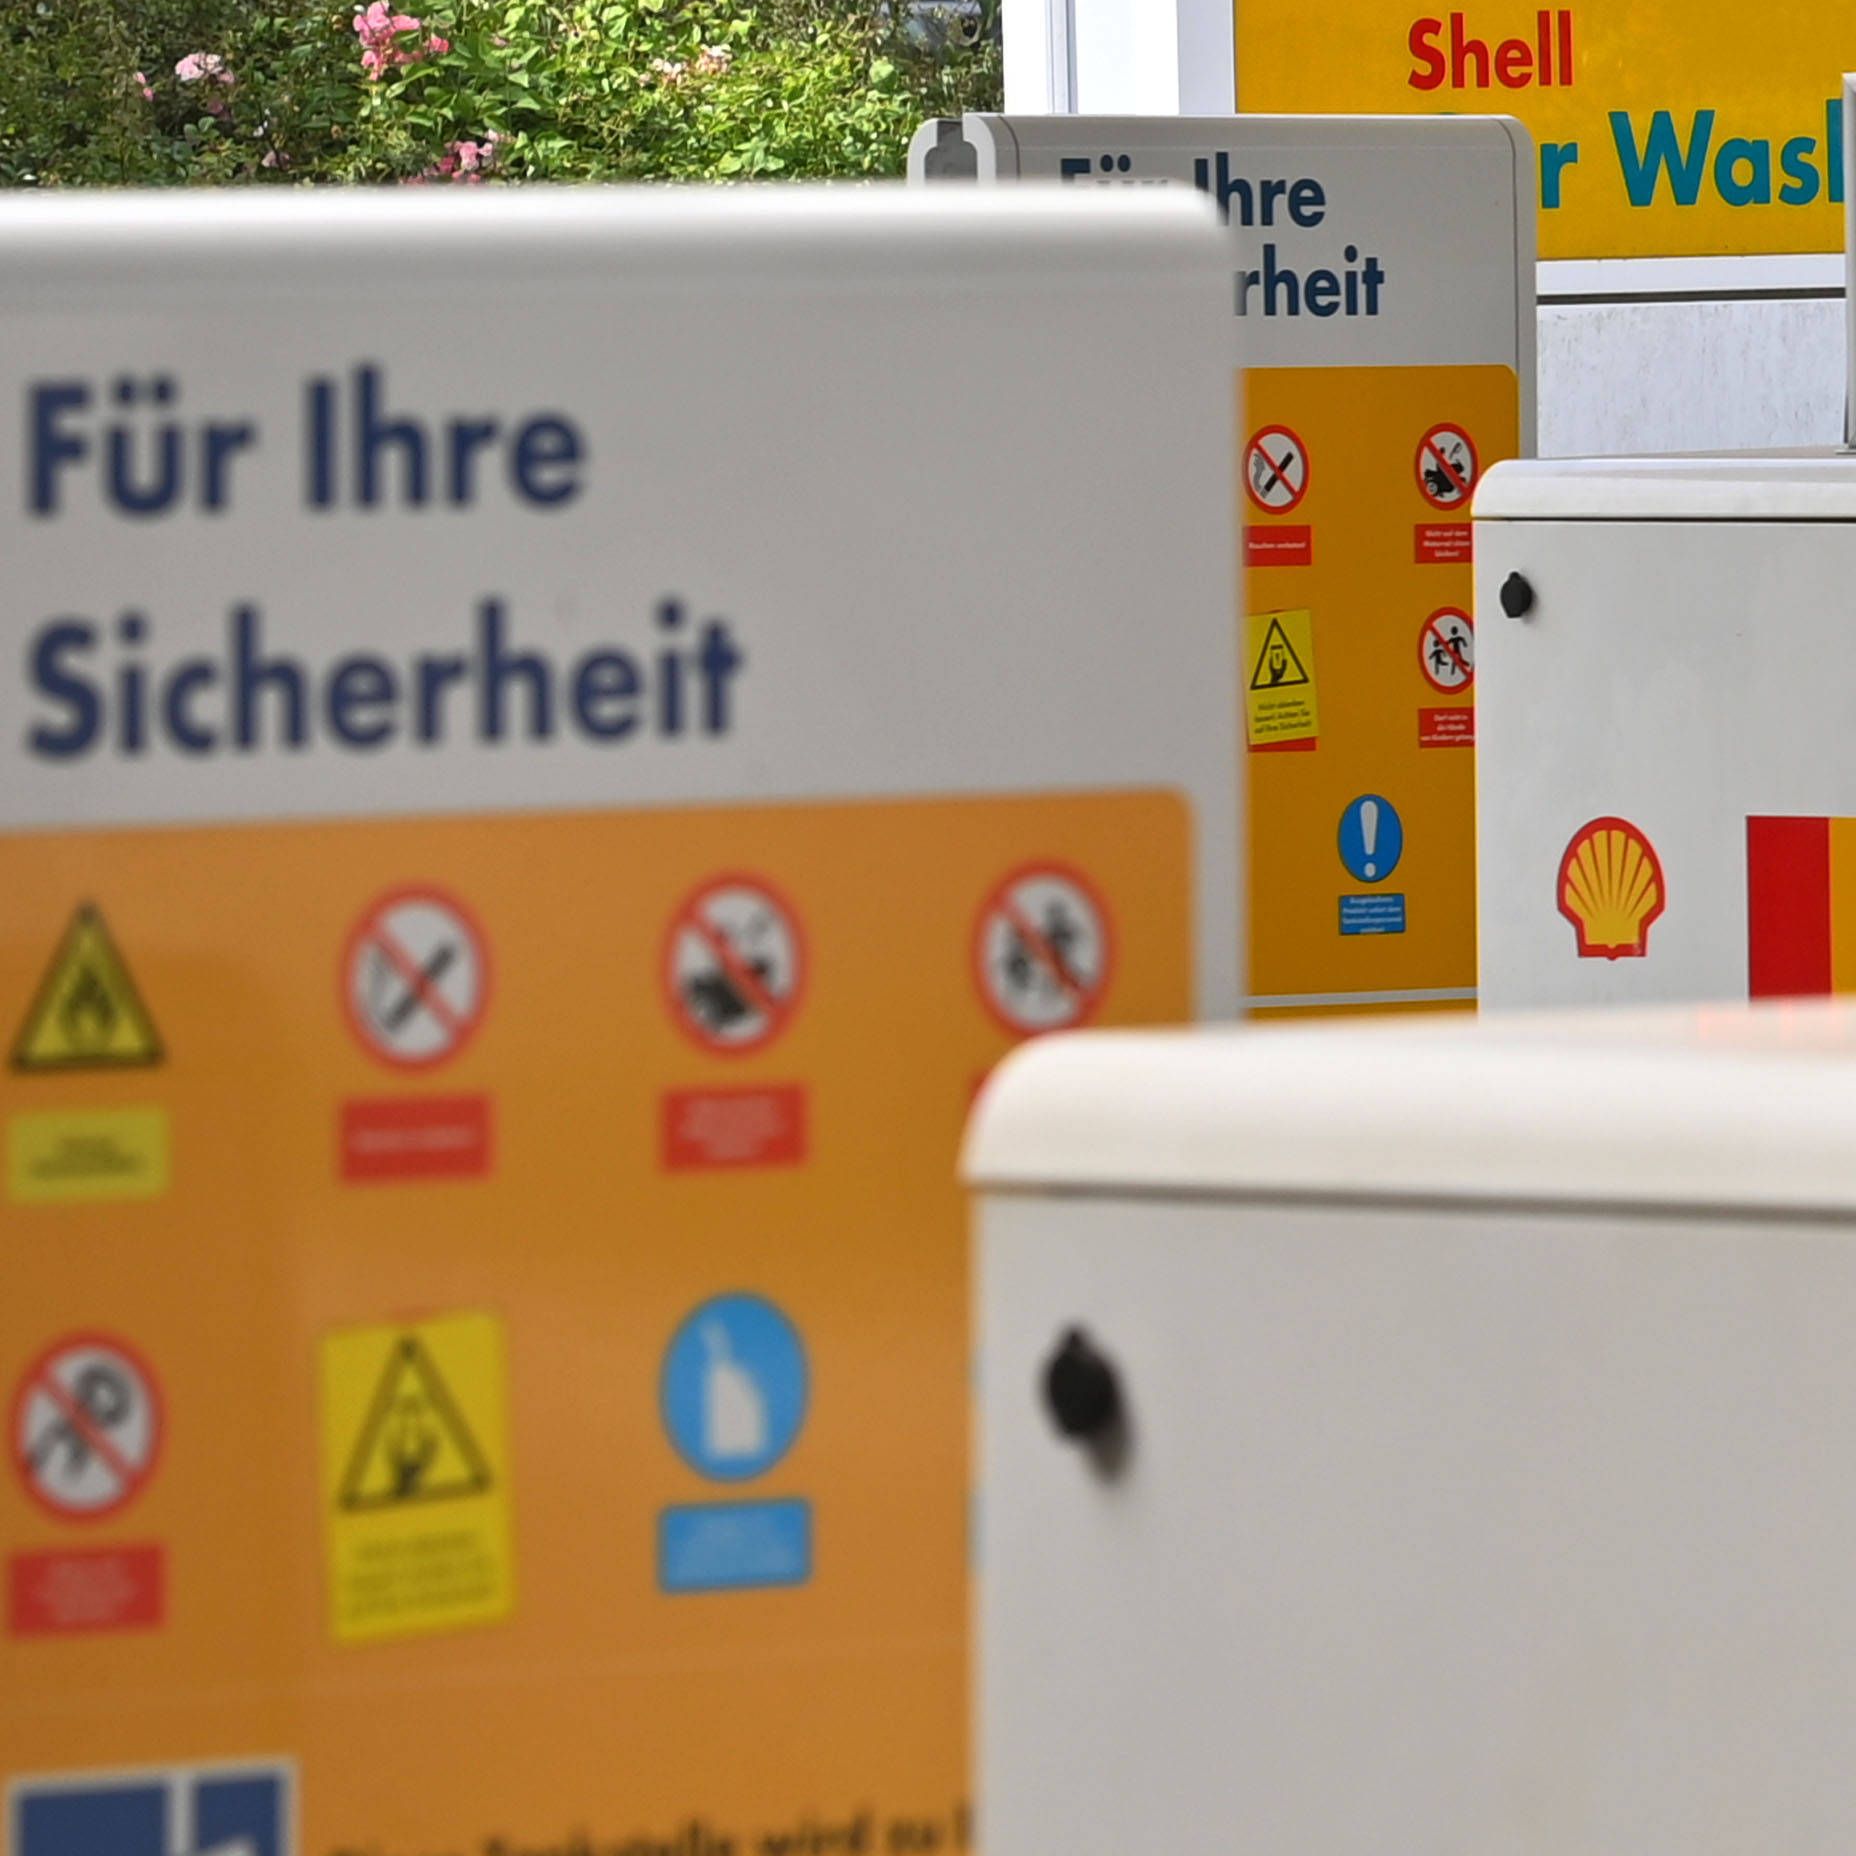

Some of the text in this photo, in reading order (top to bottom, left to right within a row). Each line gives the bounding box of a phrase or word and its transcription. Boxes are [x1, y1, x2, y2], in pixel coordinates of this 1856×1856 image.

[1407, 9, 1575, 91] Shell
[1195, 152, 1326, 228] Ihre
[27, 363, 588, 519] Für Ihre
[26, 596, 743, 763] Sicherheit
